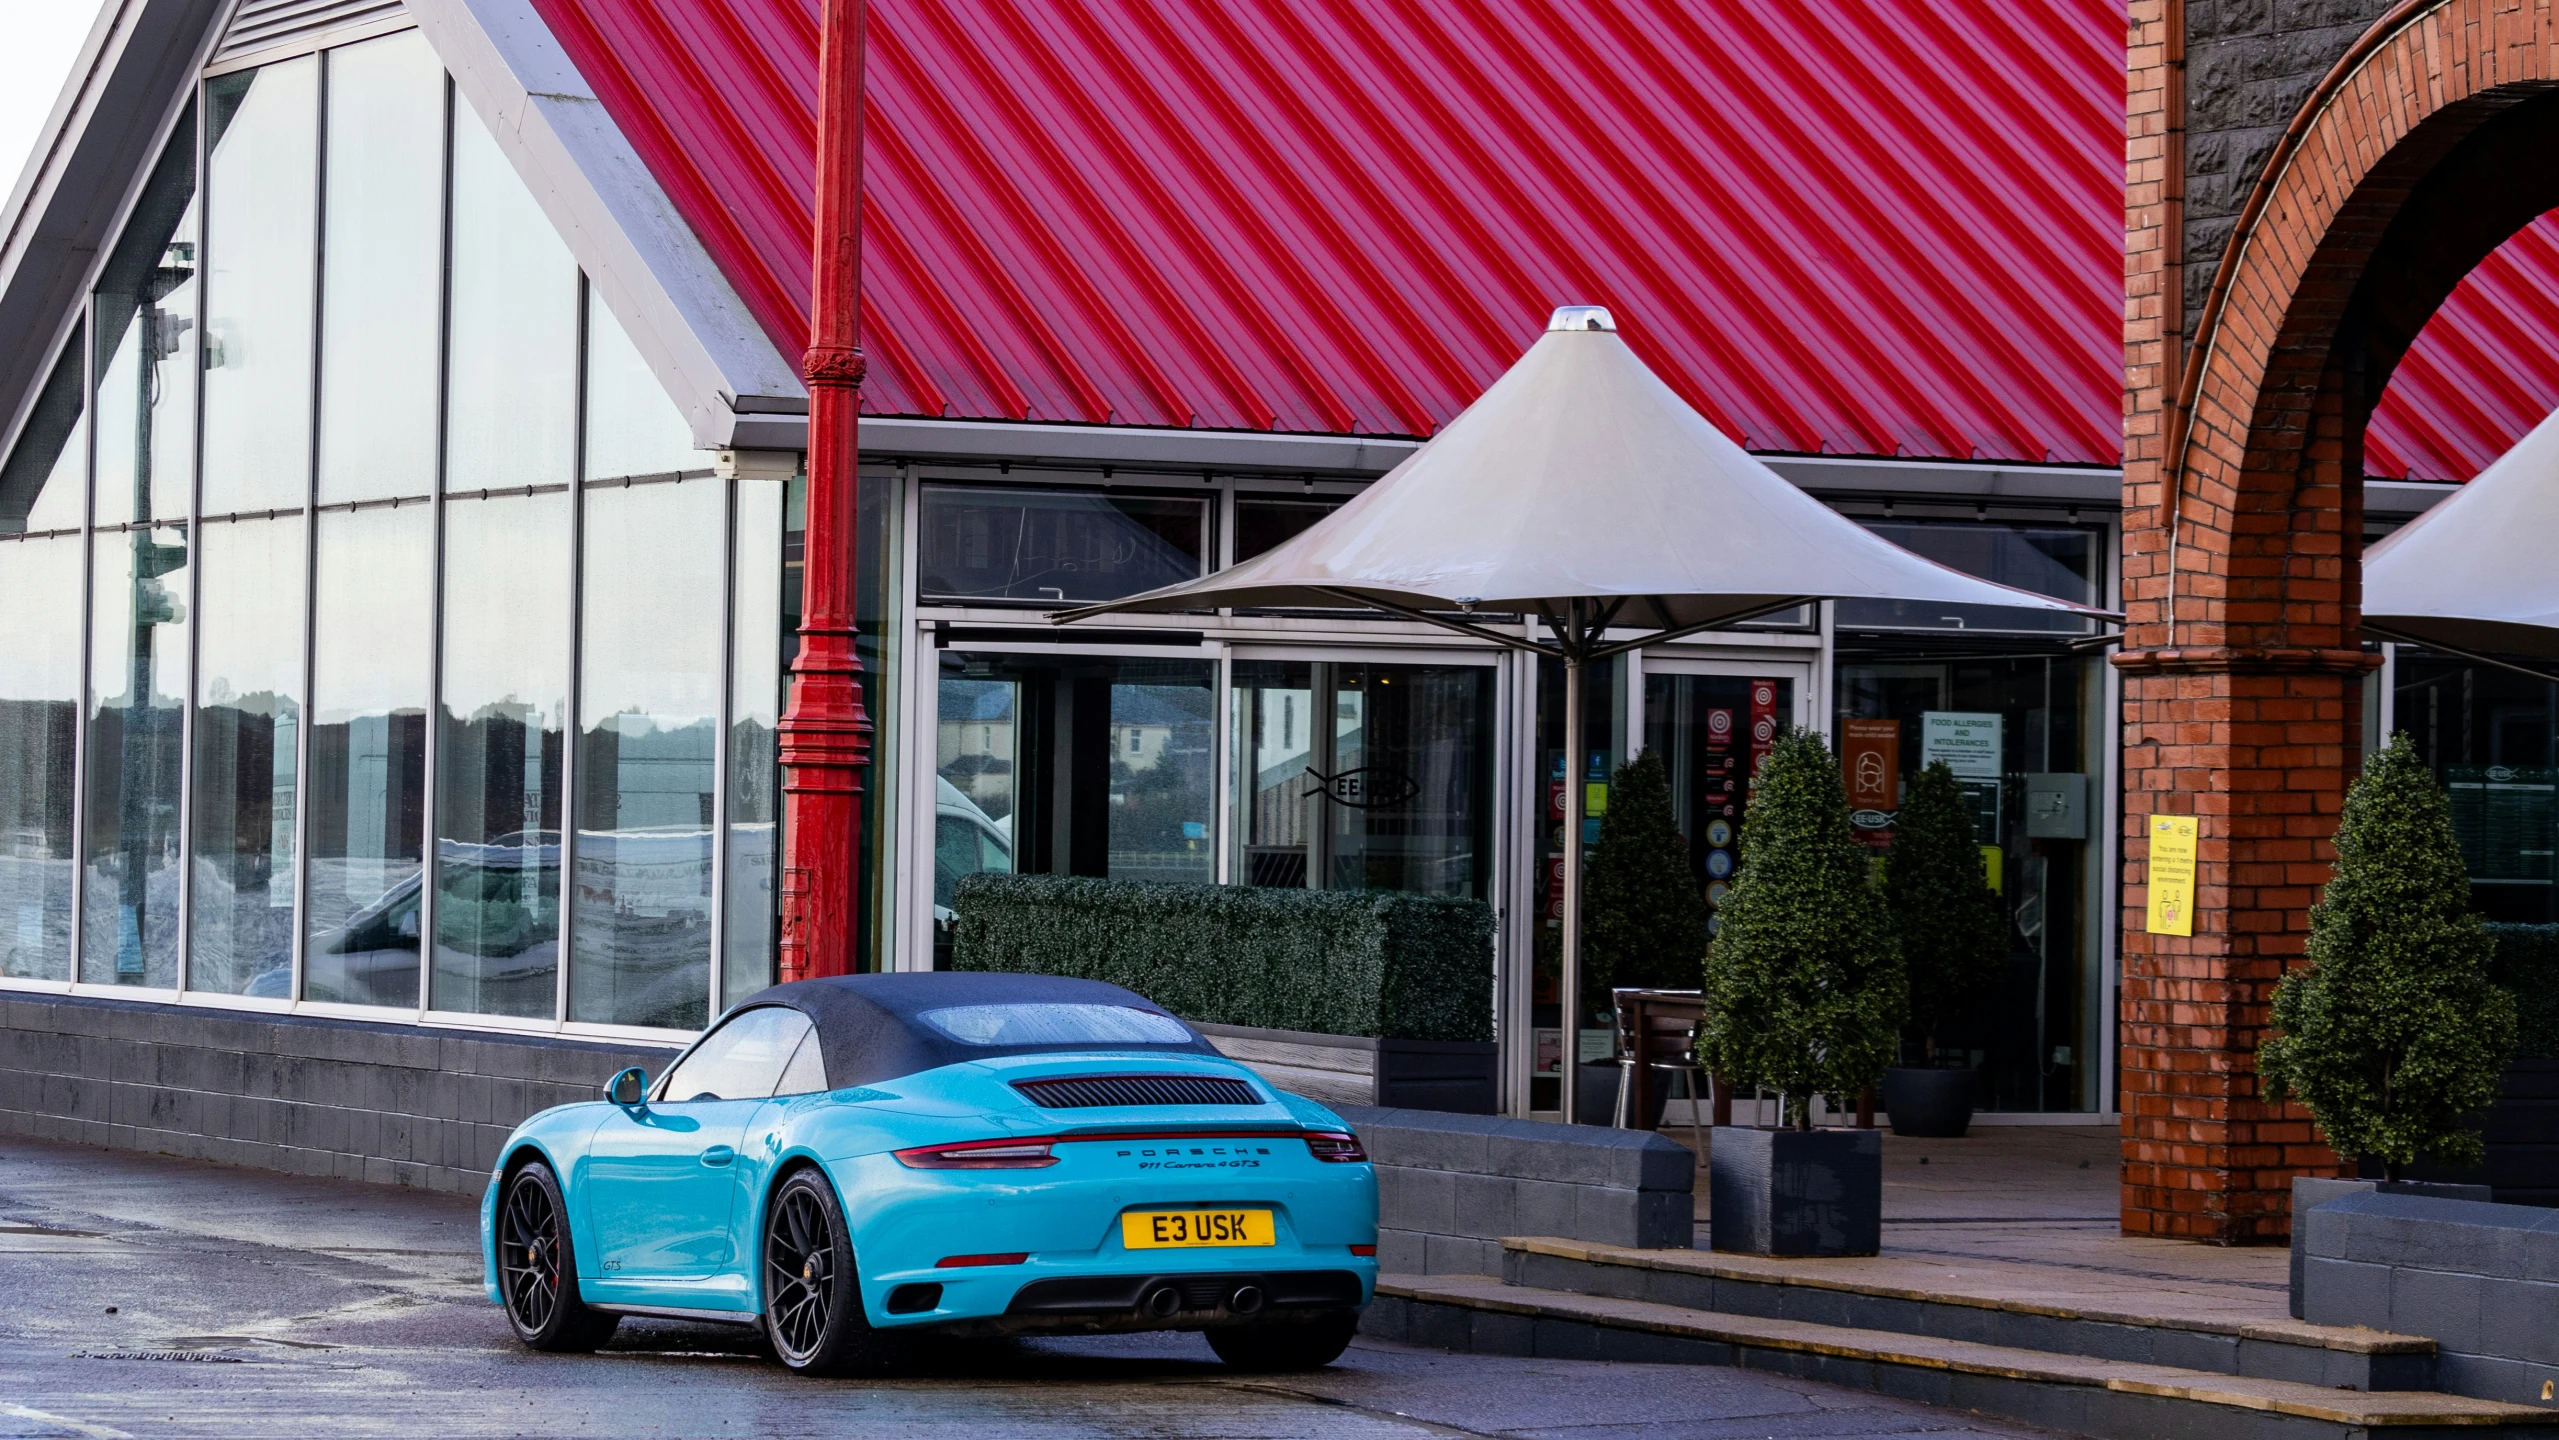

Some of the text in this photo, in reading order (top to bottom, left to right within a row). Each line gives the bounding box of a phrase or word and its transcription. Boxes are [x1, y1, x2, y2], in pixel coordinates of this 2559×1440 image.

[1931, 718, 1993, 728] FOOD ALLERGIES
[1934, 738, 1989, 747] INTOLERANCES
[1117, 1148, 1271, 1157] PORSCHE
[1164, 1161, 1216, 1169] Carrera
[1228, 1160, 1260, 1168] GTS
[1152, 1214, 1247, 1242] E3 USK
[603, 1260, 622, 1271] GTS
